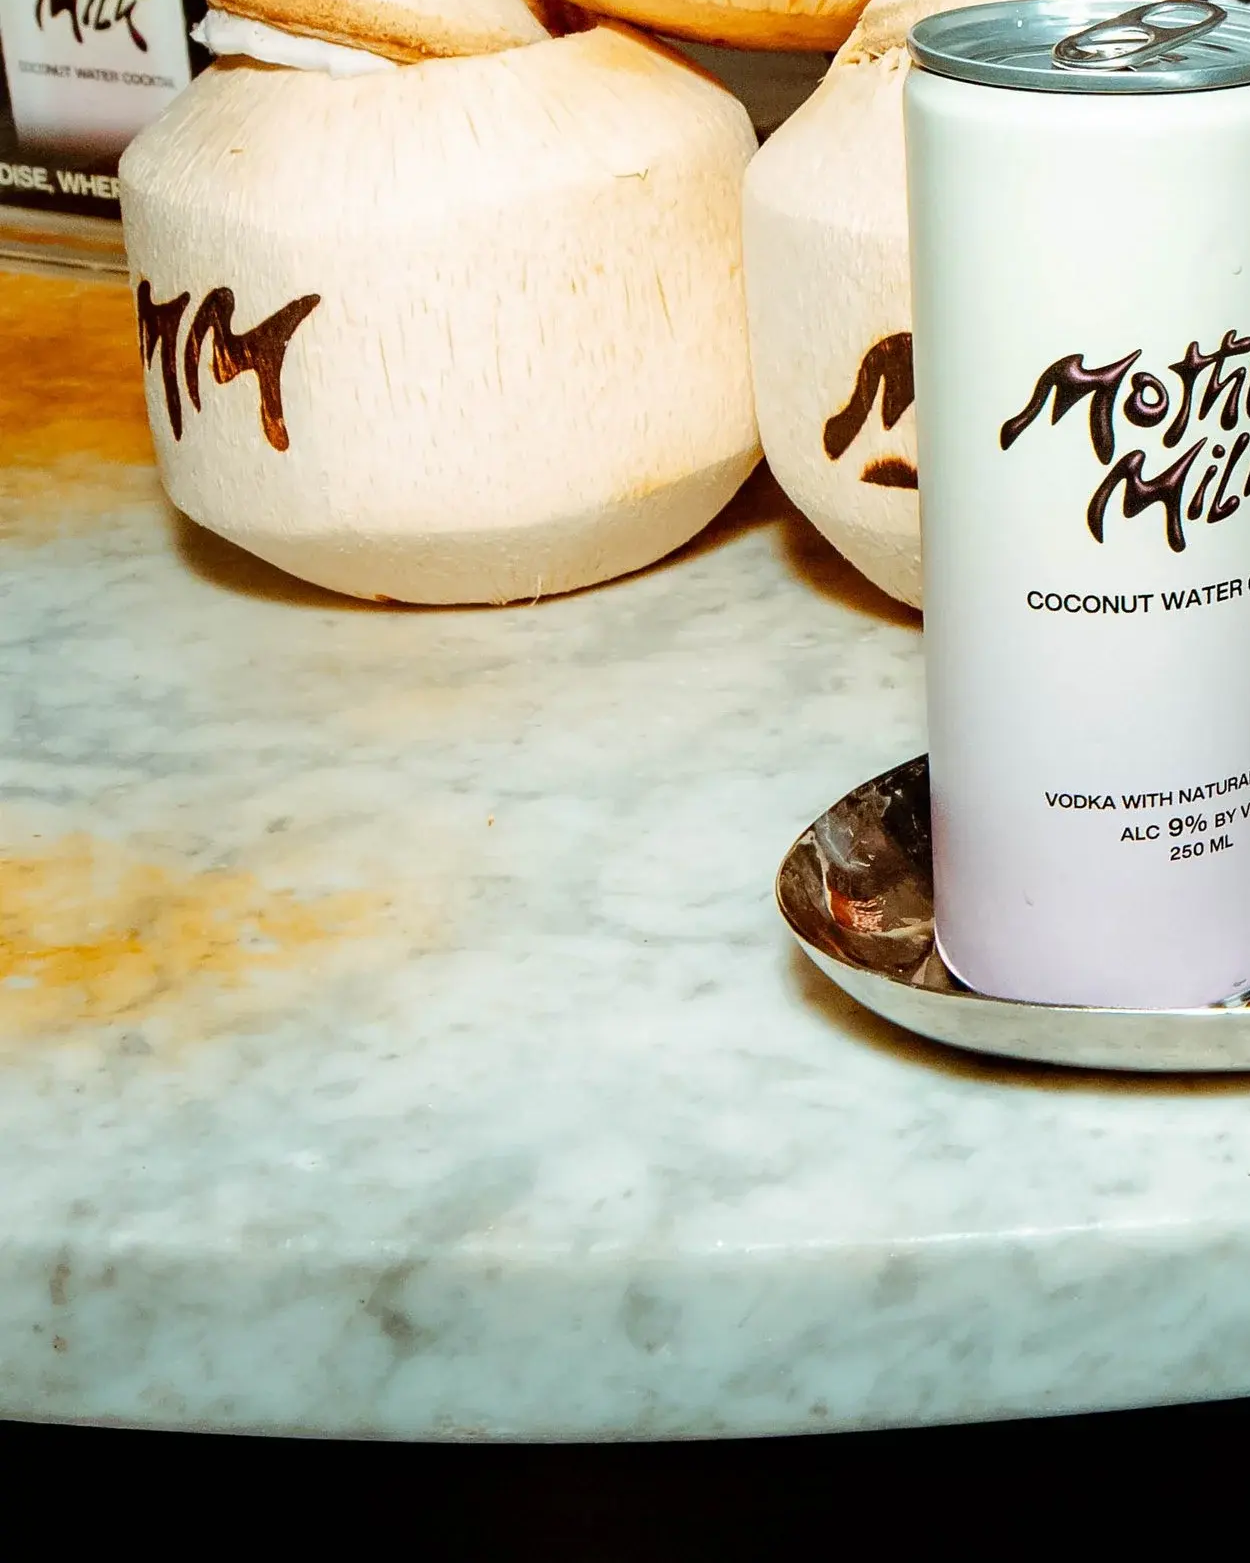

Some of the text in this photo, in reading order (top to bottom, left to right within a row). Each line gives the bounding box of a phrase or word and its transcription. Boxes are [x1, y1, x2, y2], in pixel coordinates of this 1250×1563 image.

[1026, 590, 1155, 615] COCONUT
[1161, 578, 1243, 611] WATER
[1045, 791, 1117, 810] VODKA
[1122, 791, 1173, 809] WITH
[1120, 825, 1160, 842] ALC
[1168, 814, 1207, 838] 9%
[1214, 809, 1236, 829] BY
[1170, 834, 1234, 861] 250 ML
